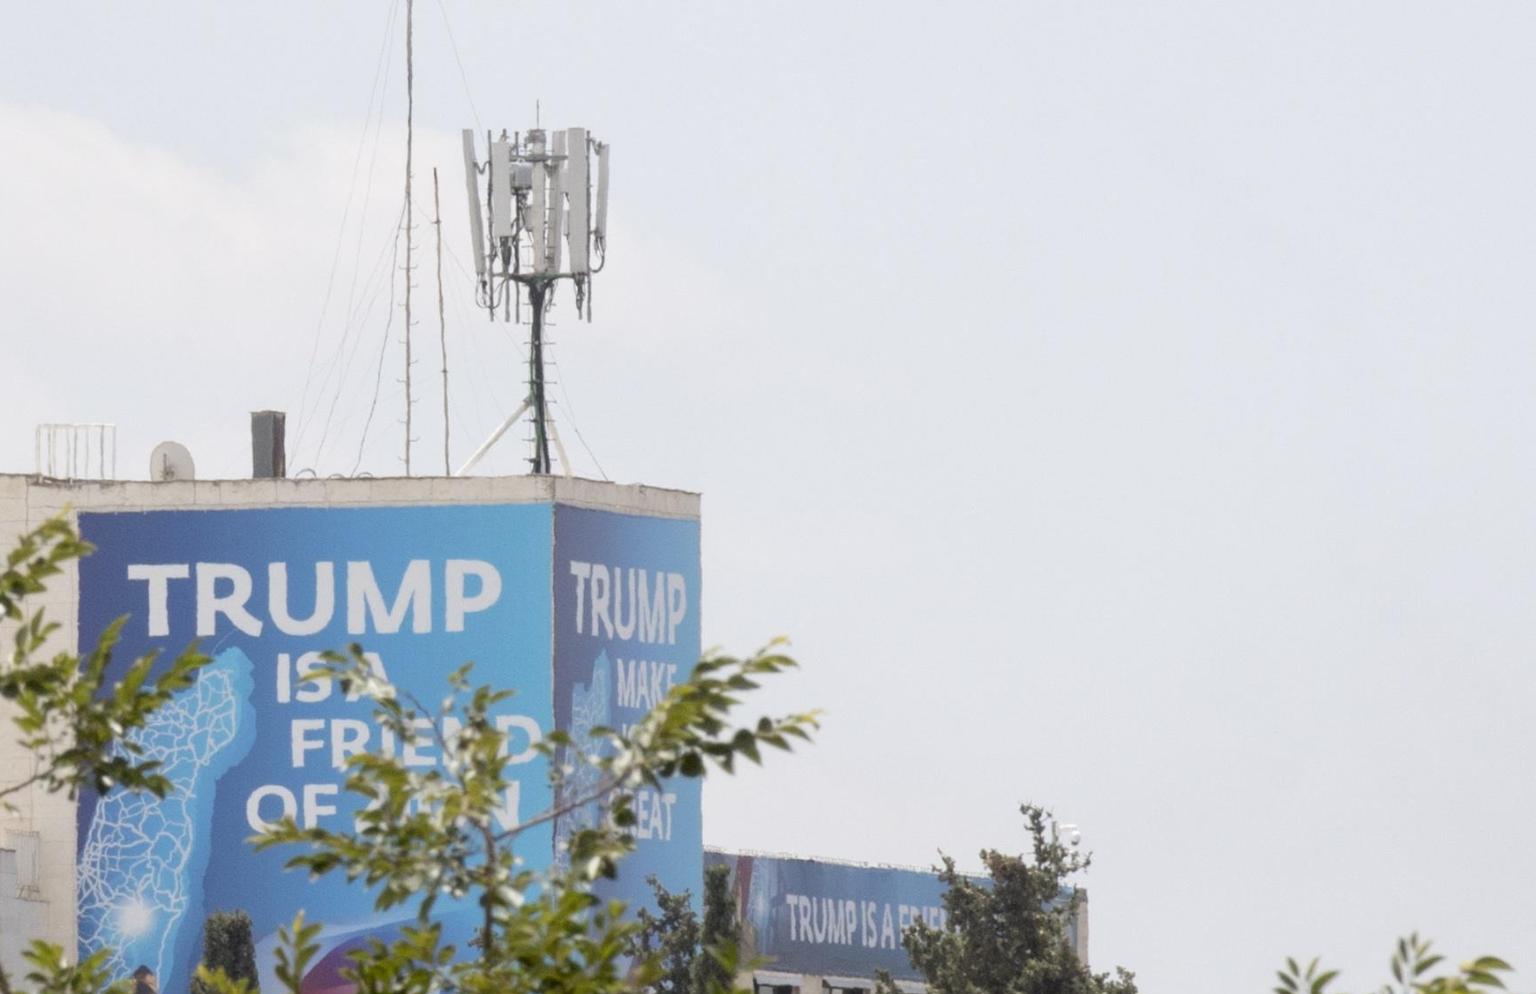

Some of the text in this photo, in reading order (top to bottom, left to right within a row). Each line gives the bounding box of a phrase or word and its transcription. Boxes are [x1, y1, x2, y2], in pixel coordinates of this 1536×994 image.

[128, 558, 502, 637] TRUMP
[569, 560, 687, 645] TRUMP
[276, 650, 332, 703] IS
[245, 783, 339, 835] OF
[785, 893, 858, 946] TRUMP
[861, 900, 878, 949] IS
[880, 902, 896, 950] A
